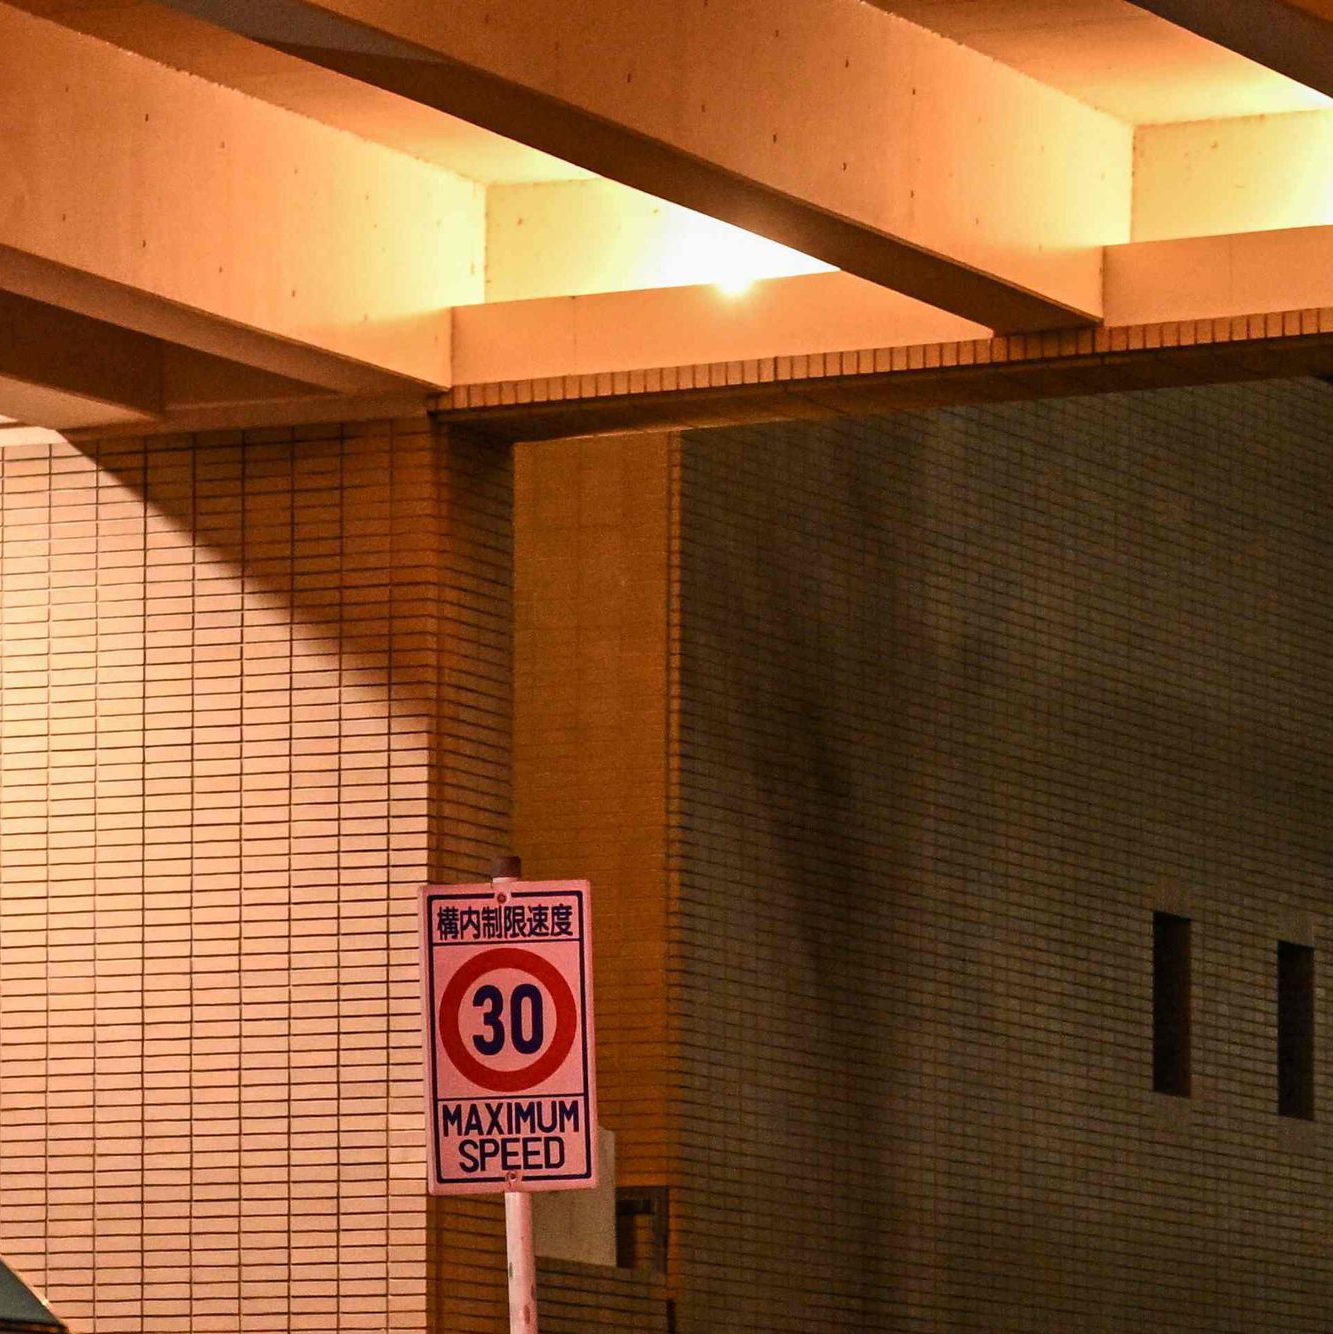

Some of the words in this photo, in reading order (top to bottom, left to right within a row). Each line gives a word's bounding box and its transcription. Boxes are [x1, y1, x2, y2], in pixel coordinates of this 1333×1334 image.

[437, 903, 574, 940] 構内制限速度
[471, 983, 544, 1056] 30
[442, 1100, 580, 1138] MAXIMUM
[458, 1136, 566, 1173] SPEED
